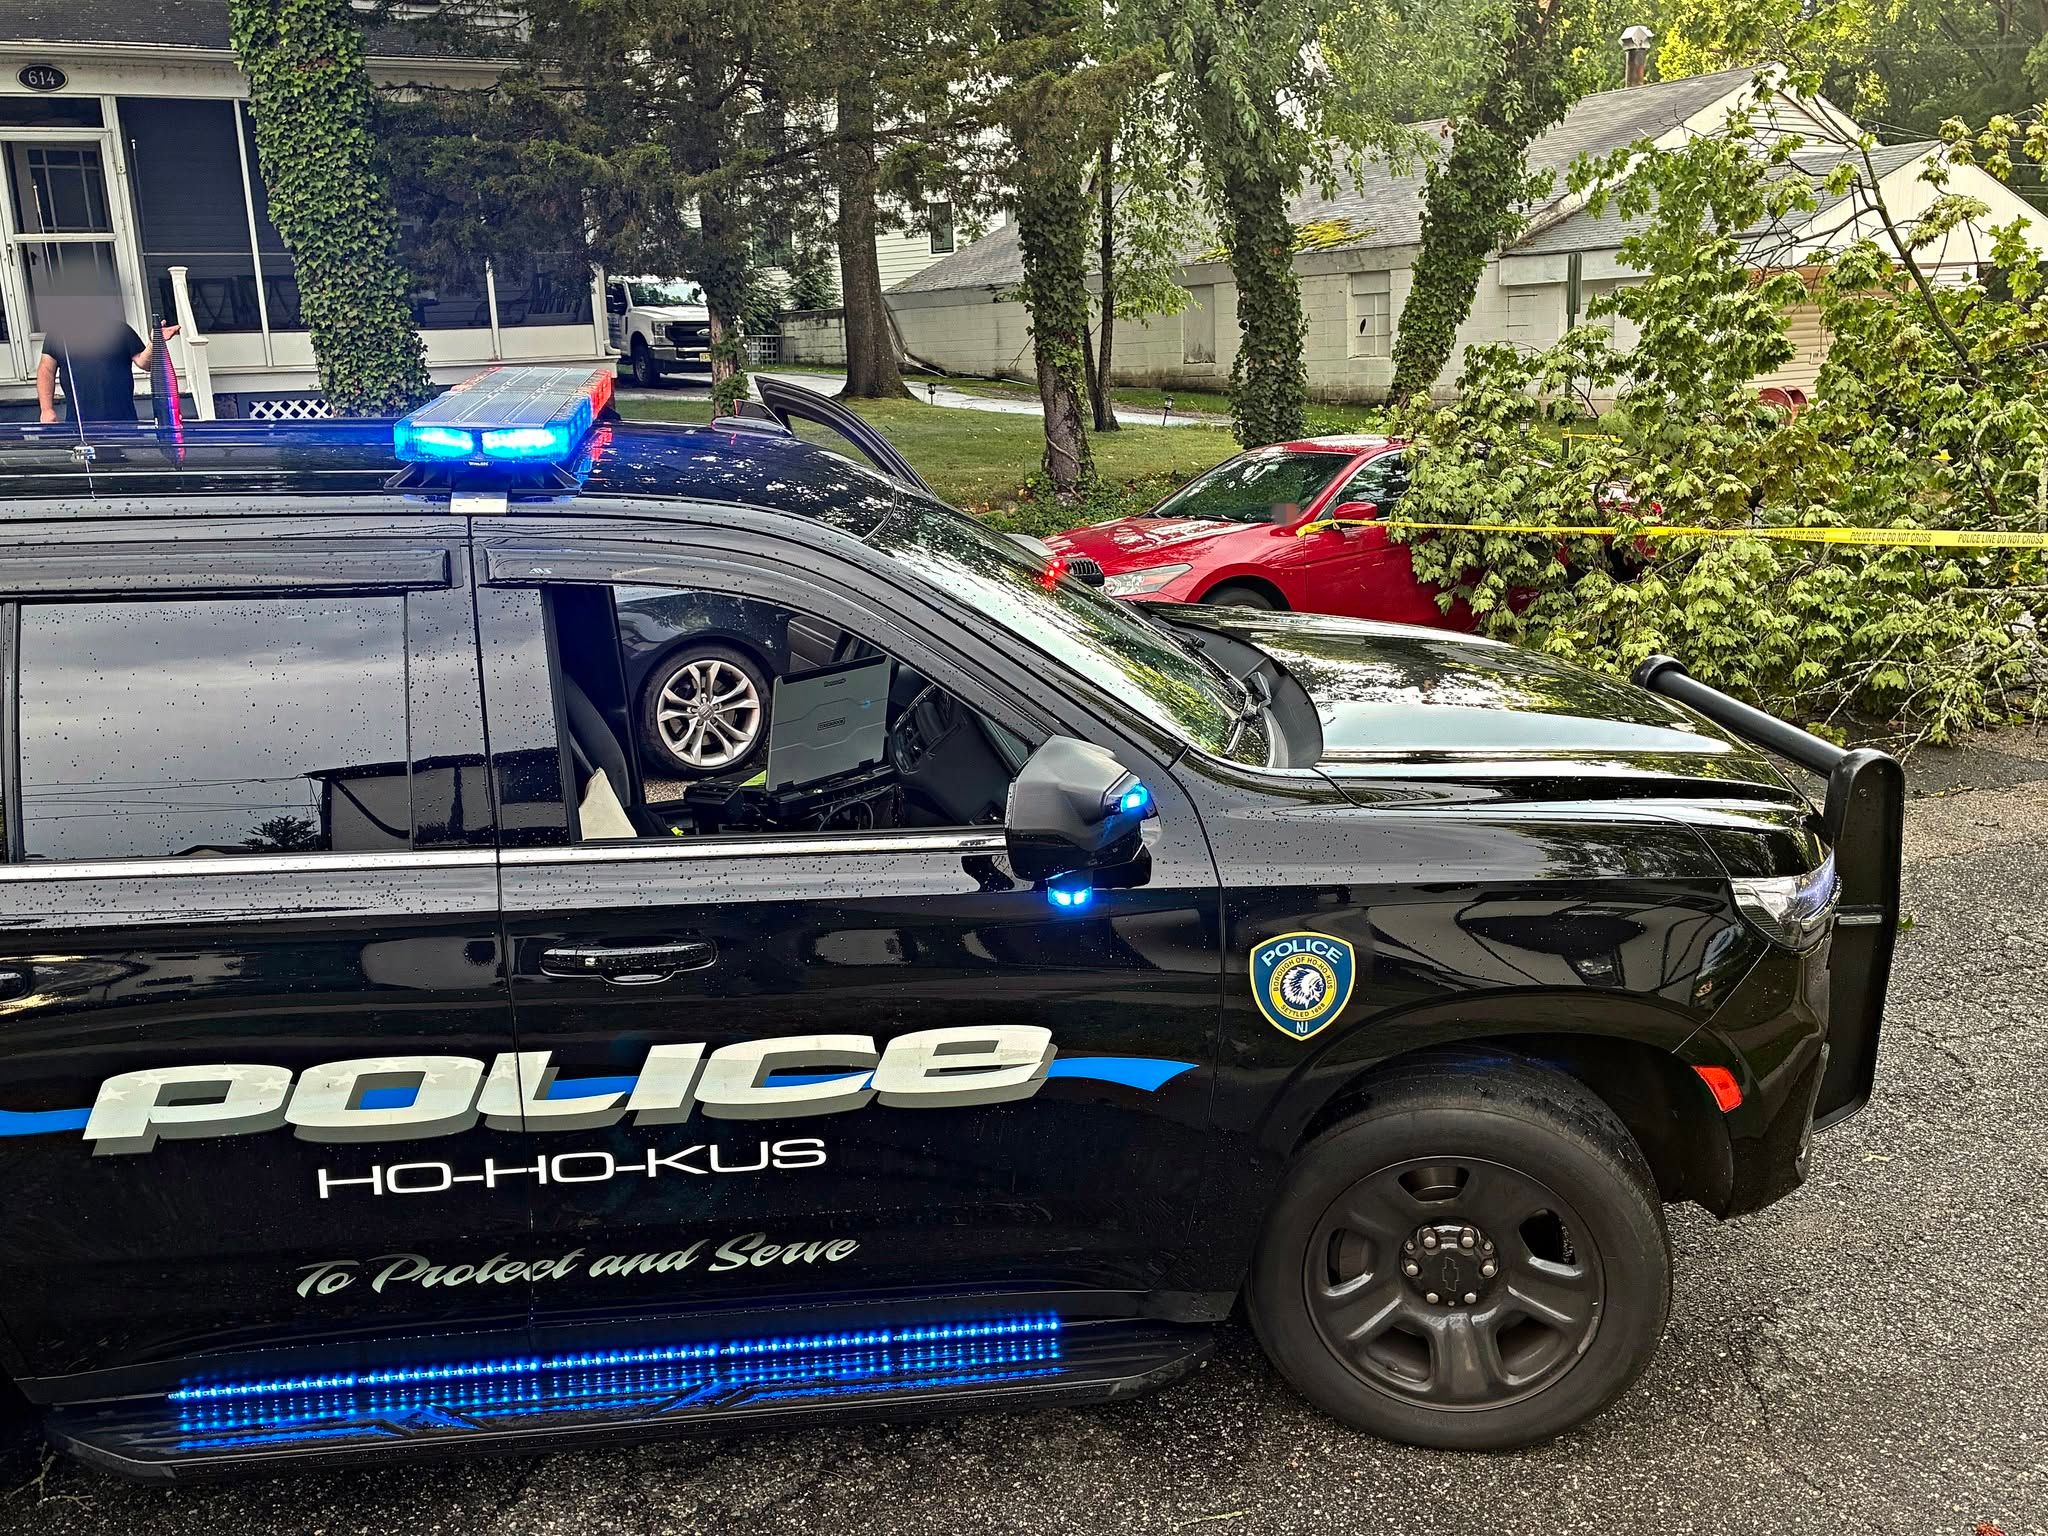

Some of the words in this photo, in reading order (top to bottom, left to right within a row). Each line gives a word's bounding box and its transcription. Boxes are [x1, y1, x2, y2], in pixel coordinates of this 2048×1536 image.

[28, 70, 55, 85] 614
[1850, 531, 1872, 541] POLICE
[1873, 532, 1887, 542] LINE
[1886, 532, 1897, 542] DO
[1897, 532, 1910, 543] NOT
[1910, 533, 1932, 543] CROSS
[1957, 533, 1980, 543] POLICE
[1981, 534, 1996, 544] LINE
[1996, 534, 2007, 544] DO
[2007, 534, 2020, 544] NOT
[2022, 535, 2045, 545] CROSS
[1261, 939, 1343, 967] POLICE
[1273, 960, 1295, 991] BOROUGH
[1295, 956, 1306, 964] OF
[1306, 957, 1334, 990] HO-HO-KUS
[1280, 1004, 1310, 1018] SETTLED
[1296, 1021, 1308, 1034] NJ
[317, 1137, 828, 1199] HO-HO-KUS
[296, 1259, 360, 1299] To
[365, 1247, 586, 1295] Protect
[588, 1238, 711, 1277] and
[707, 1231, 862, 1273] Serve
